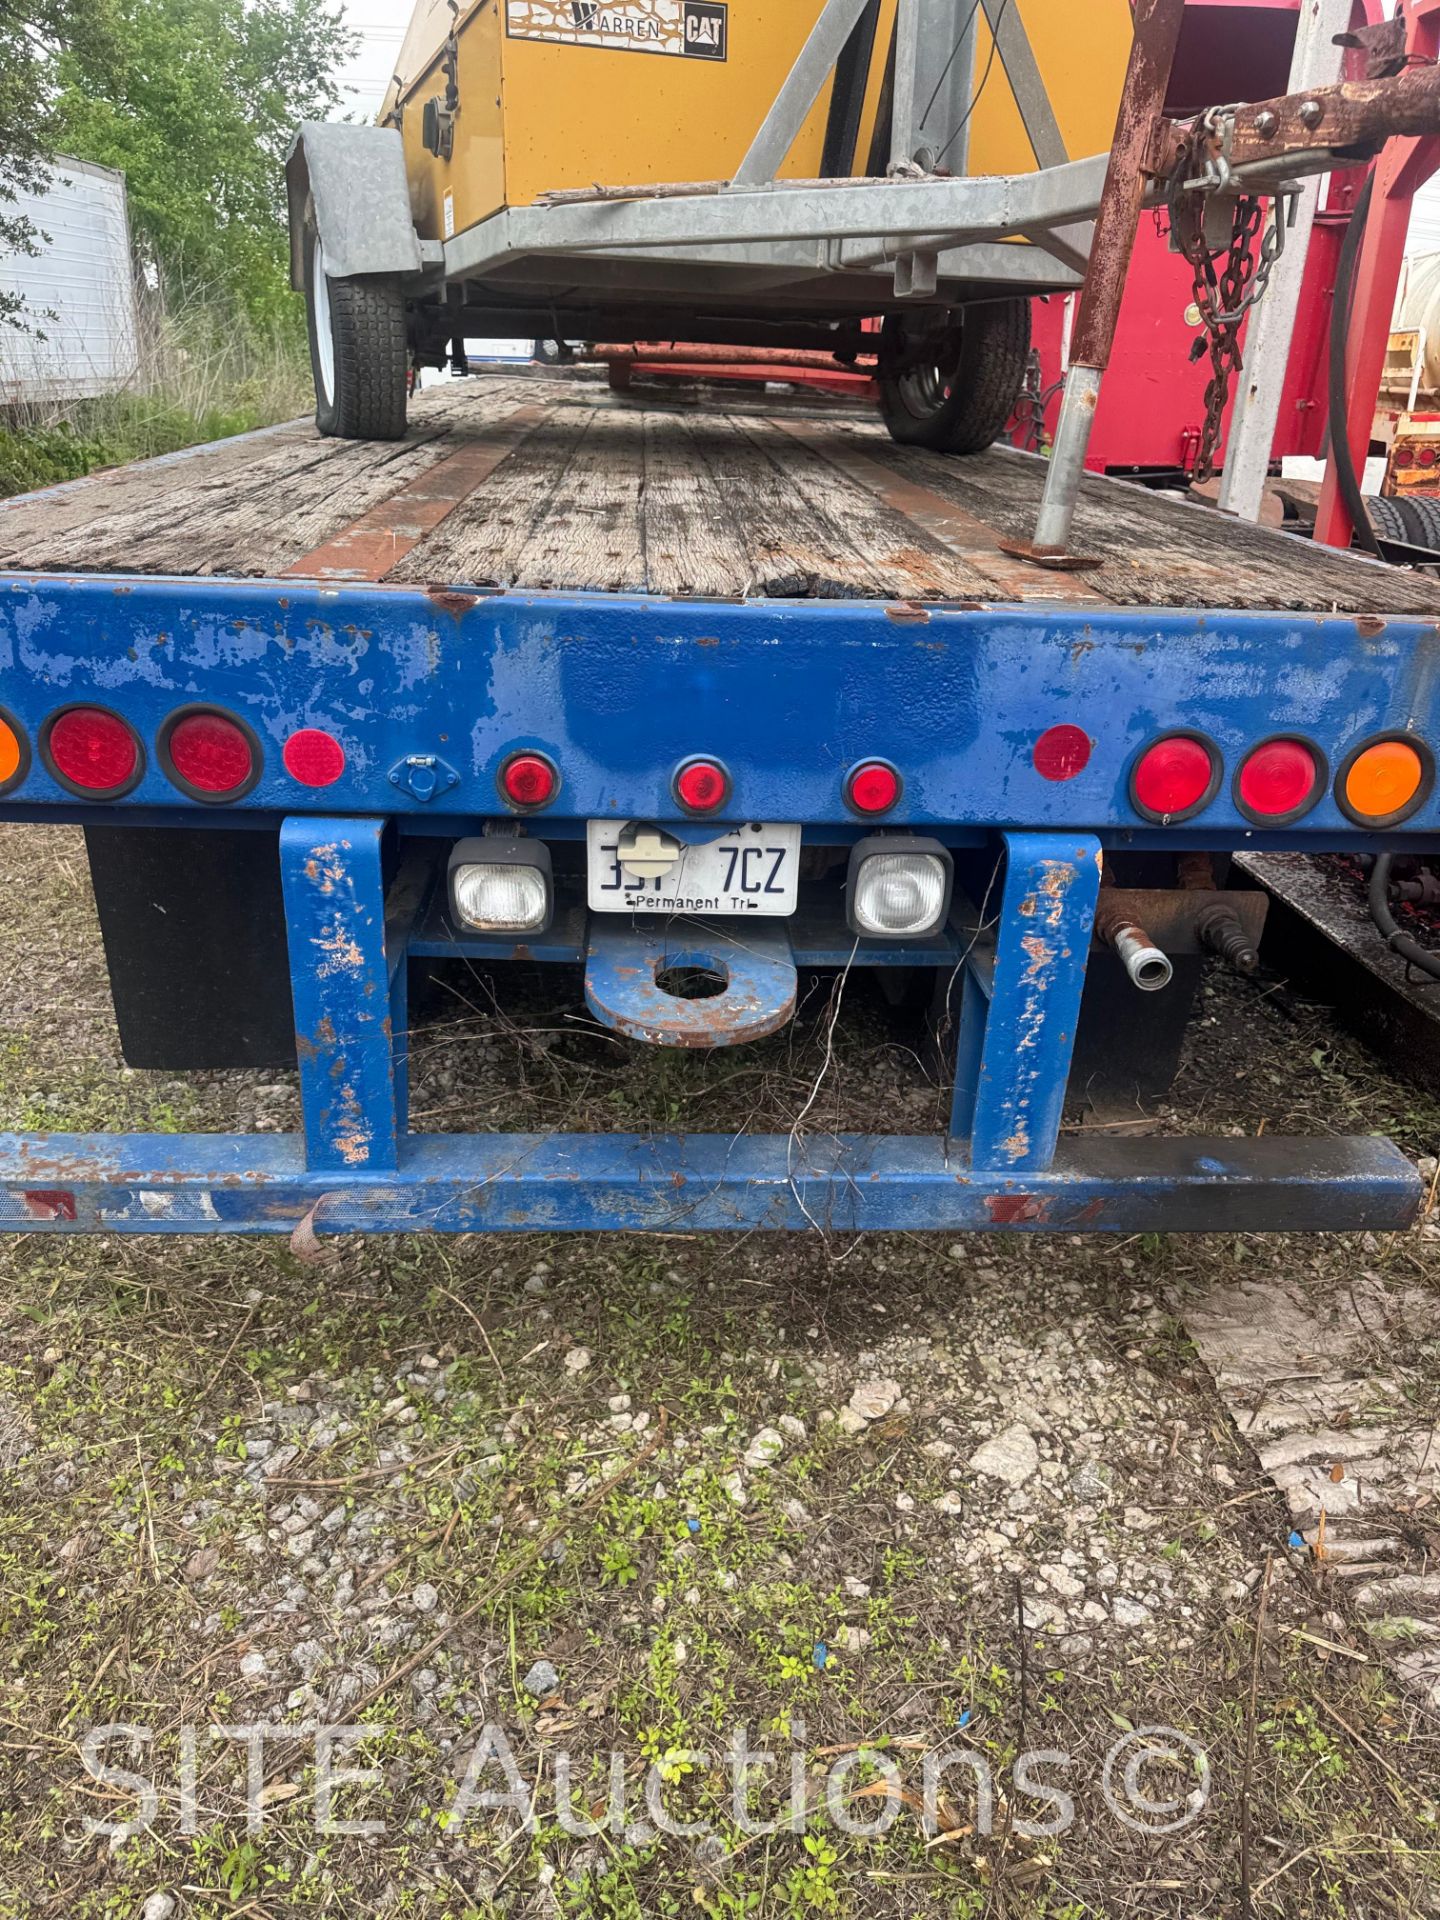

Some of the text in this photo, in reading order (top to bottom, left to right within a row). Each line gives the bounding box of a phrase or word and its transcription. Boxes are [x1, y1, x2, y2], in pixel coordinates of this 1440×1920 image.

[570, 1, 660, 39] WARREN
[686, 14, 723, 46] CAT
[718, 847, 787, 894] 7CZ
[636, 895, 720, 910] Permanent
